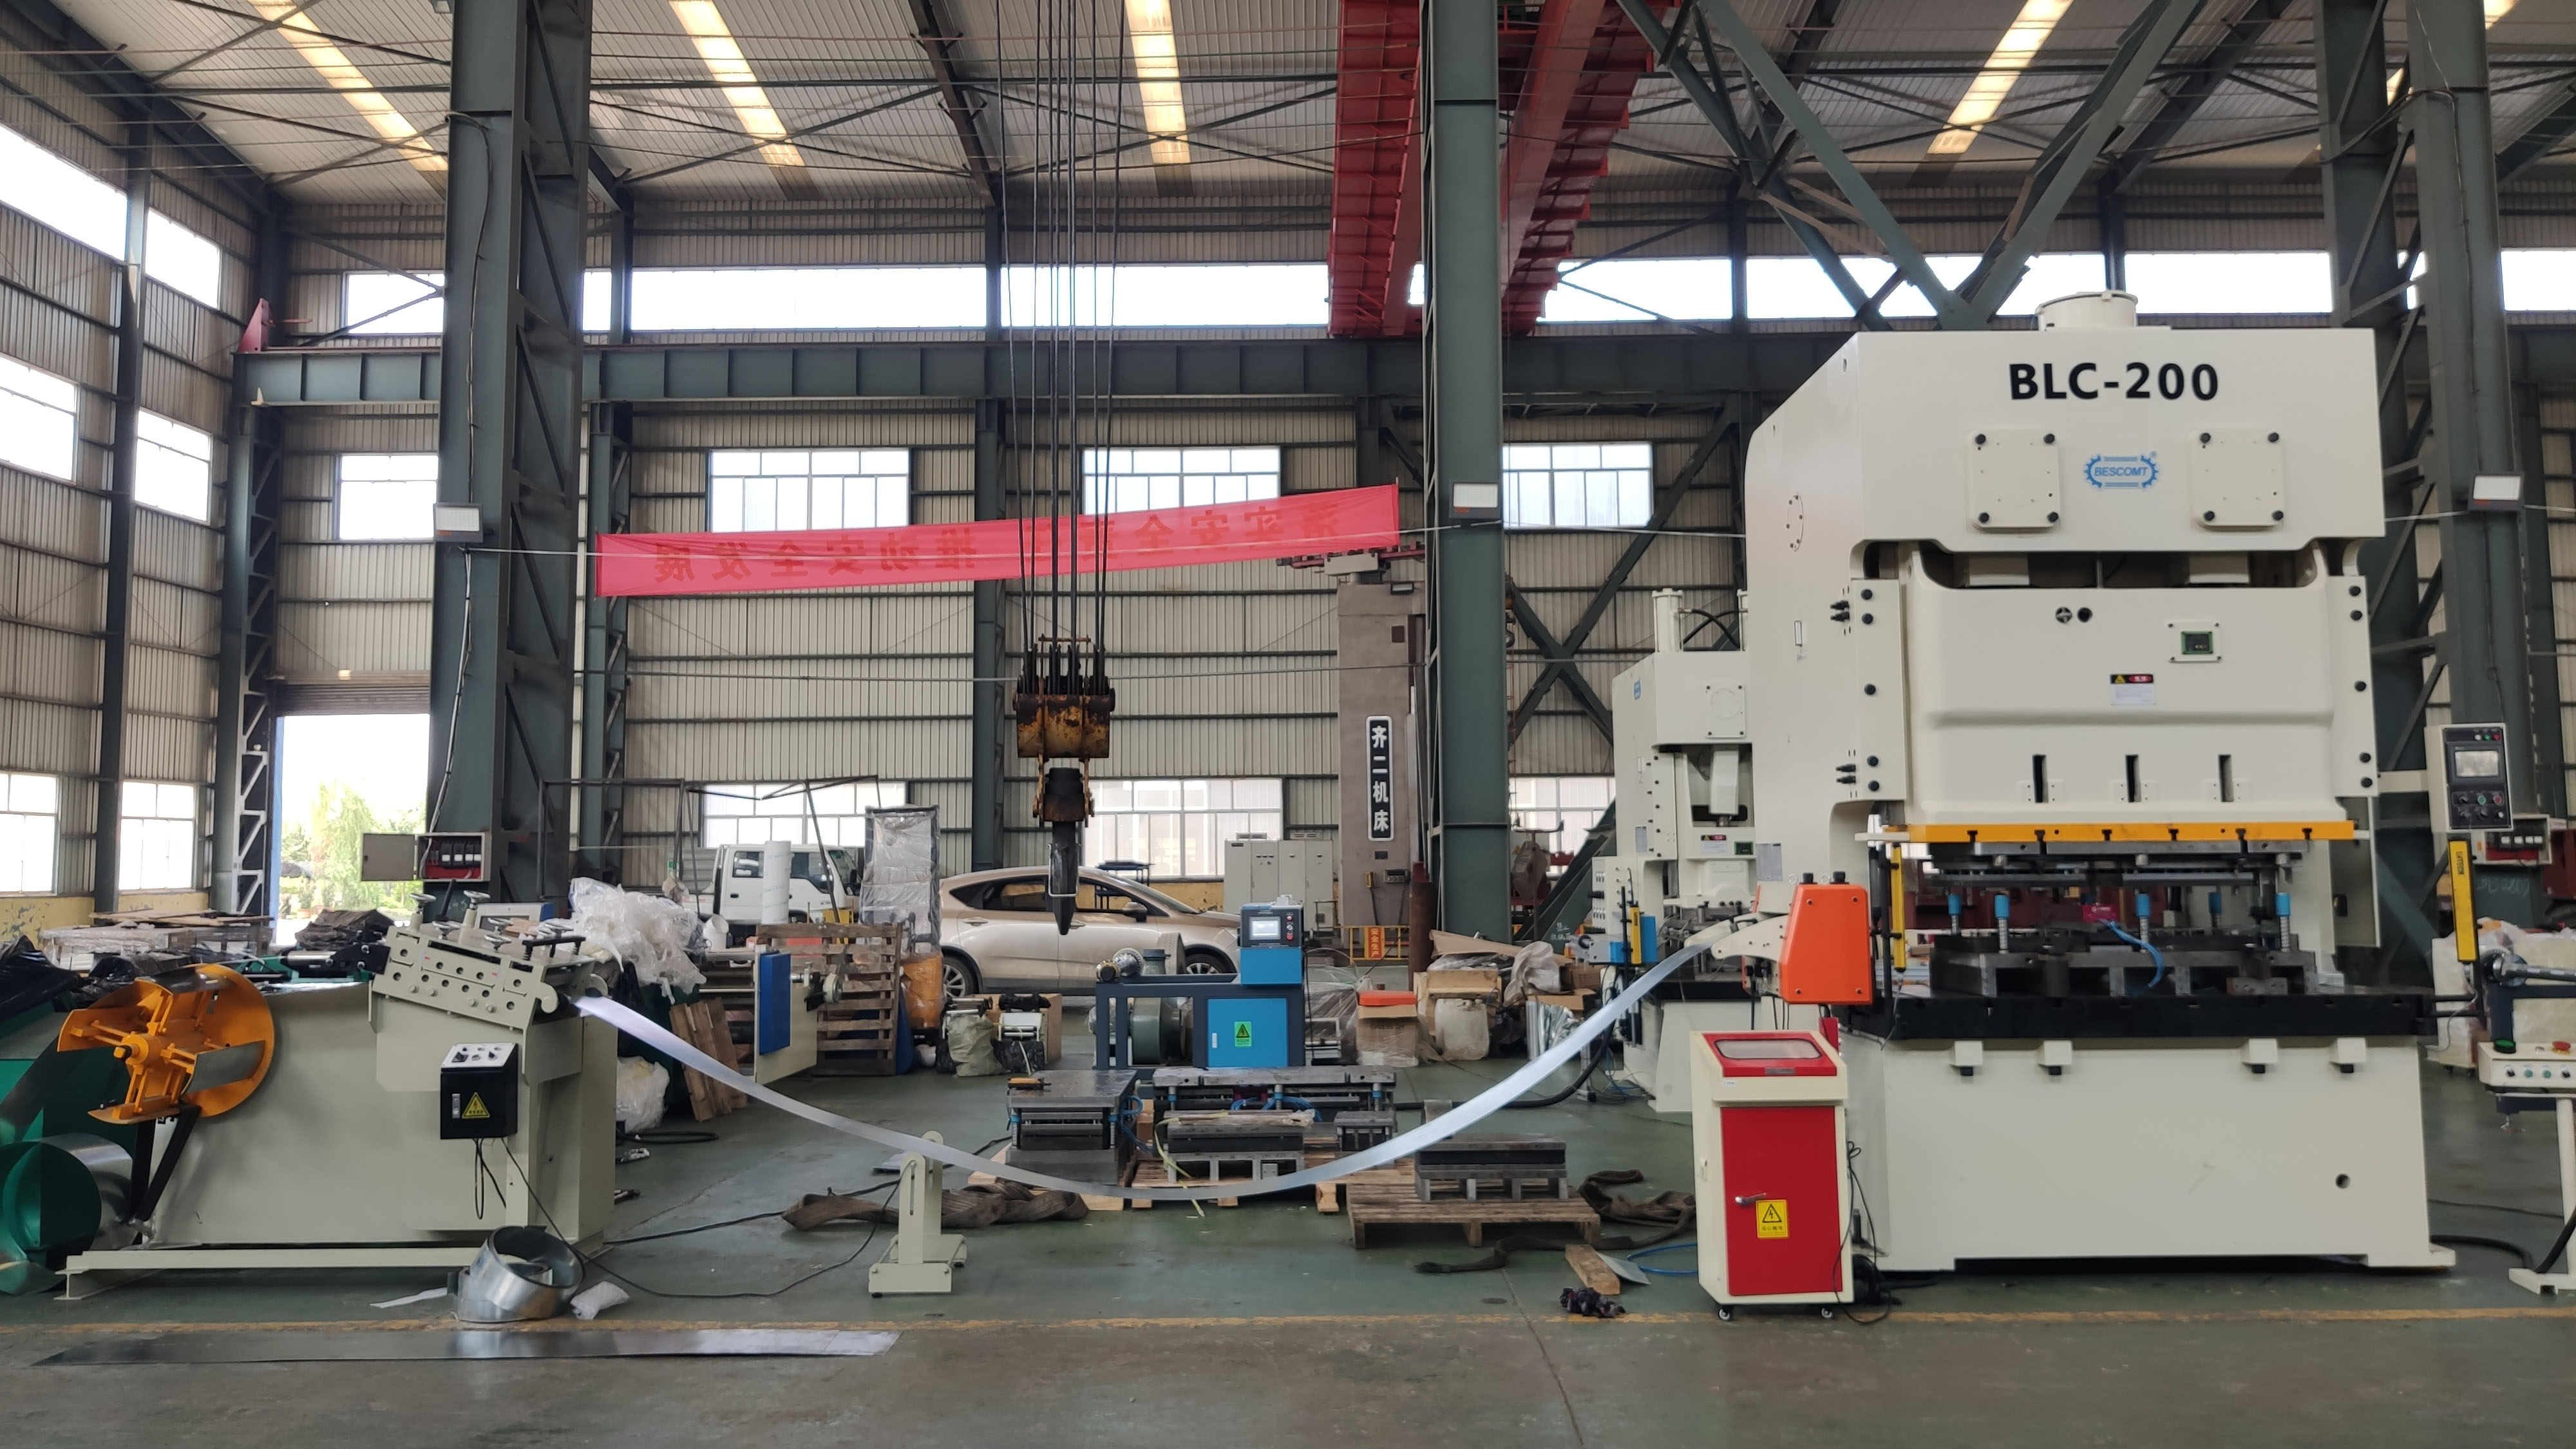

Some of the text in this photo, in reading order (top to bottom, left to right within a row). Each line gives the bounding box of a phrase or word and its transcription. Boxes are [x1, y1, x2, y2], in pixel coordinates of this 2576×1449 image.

[2008, 362, 2219, 400] BLC-200
[2094, 466, 2149, 477] BESCOMT
[1371, 725, 1389, 832] 齐二机床
